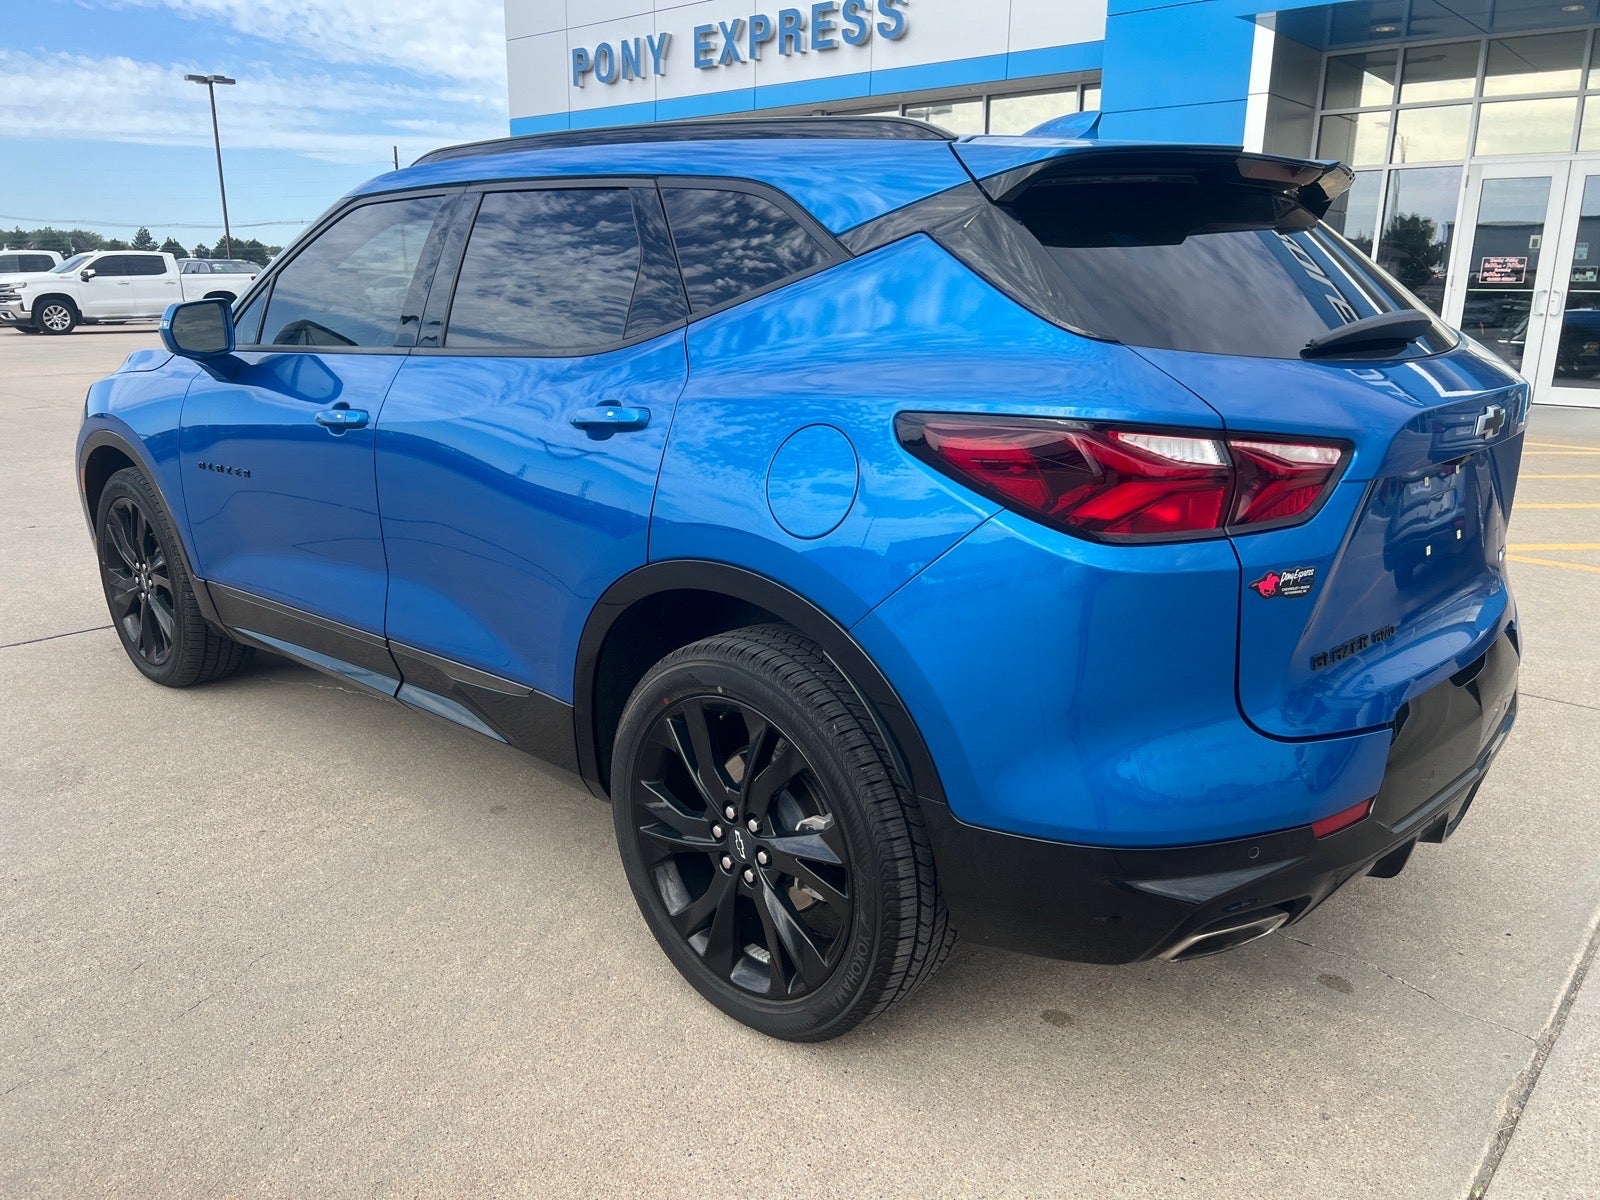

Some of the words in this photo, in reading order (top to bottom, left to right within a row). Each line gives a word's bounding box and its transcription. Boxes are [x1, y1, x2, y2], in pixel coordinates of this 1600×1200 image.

[572, 32, 672, 87] PONY
[694, 0, 911, 70] EXPRESS
[198, 461, 251, 478] BLAZER
[831, 934, 872, 1009] YOKOHAMA
